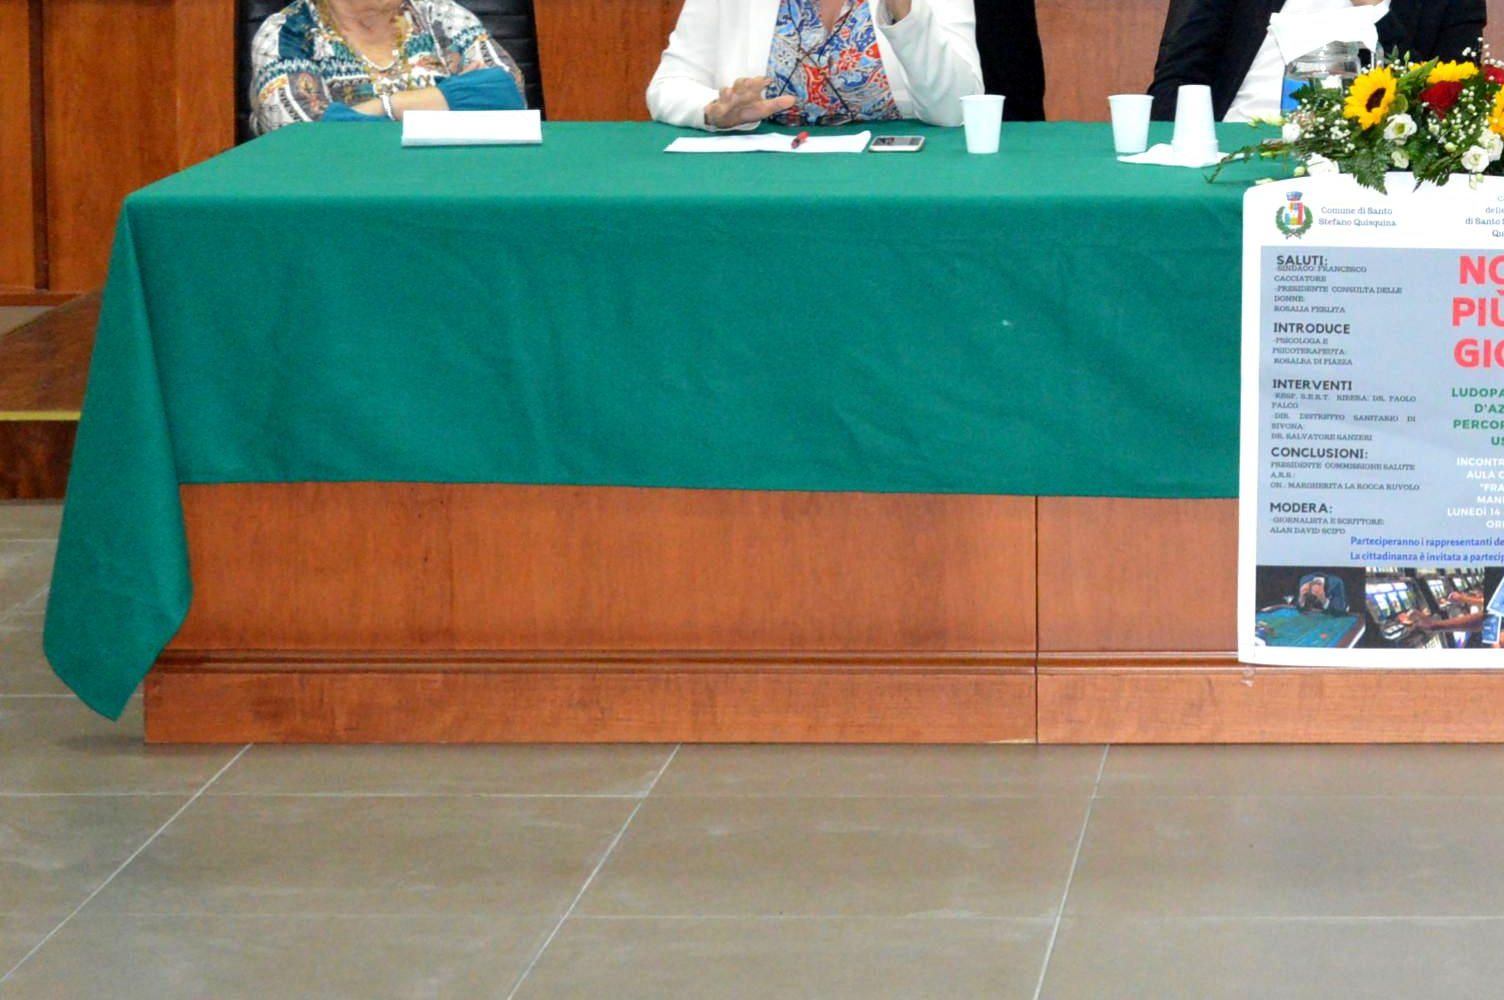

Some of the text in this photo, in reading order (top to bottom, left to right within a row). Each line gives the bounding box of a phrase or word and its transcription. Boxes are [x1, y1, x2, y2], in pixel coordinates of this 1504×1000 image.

[1321, 206, 1393, 215] Comune di Santo
[1318, 217, 1397, 228] Stefano Quisquina
[1465, 217, 1474, 225] di
[1475, 217, 1500, 226] Santo
[1276, 255, 1328, 266] SALUTI:
[1331, 286, 1375, 294] CONSULTA
[1273, 322, 1351, 334] INTRODUCE
[1272, 379, 1352, 391] INTERVENTI
[1271, 447, 1368, 459] CONCLUSIONI:
[1466, 470, 1496, 480] AULA
[1270, 502, 1333, 514] MODERA:
[1447, 506, 1487, 517] LUNEDÌ
[1490, 508, 1500, 517] 14
[1350, 536, 1420, 548] Parteciperanno
[1425, 537, 1493, 549] rappresentanti
[1350, 552, 1361, 561] La
[1361, 552, 1418, 561] cittadinanza
[1426, 552, 1461, 561] invitata
